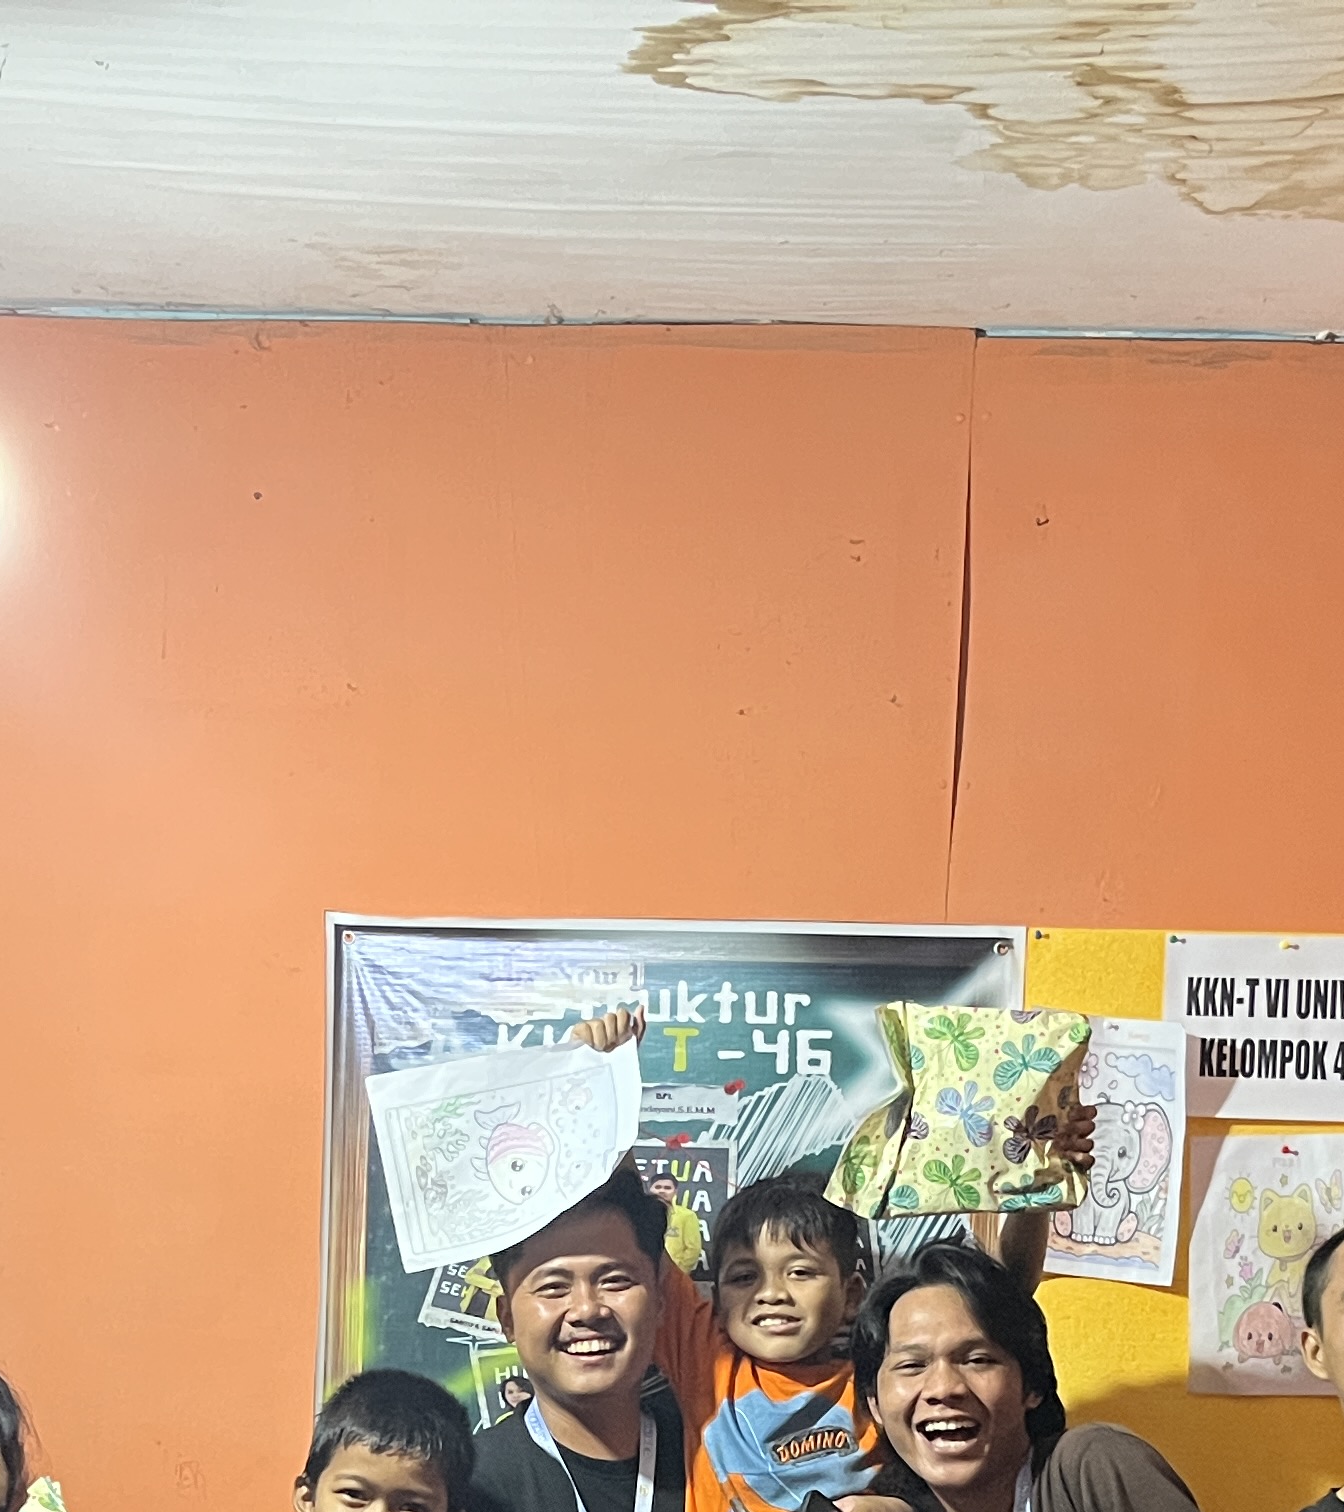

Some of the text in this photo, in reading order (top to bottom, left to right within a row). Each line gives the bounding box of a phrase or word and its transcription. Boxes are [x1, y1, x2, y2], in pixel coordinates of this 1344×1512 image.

[1186, 977, 1260, 1018] KKN-T
[1265, 978, 1292, 1019] VI
[1199, 1037, 1328, 1080] KELOMPOK
